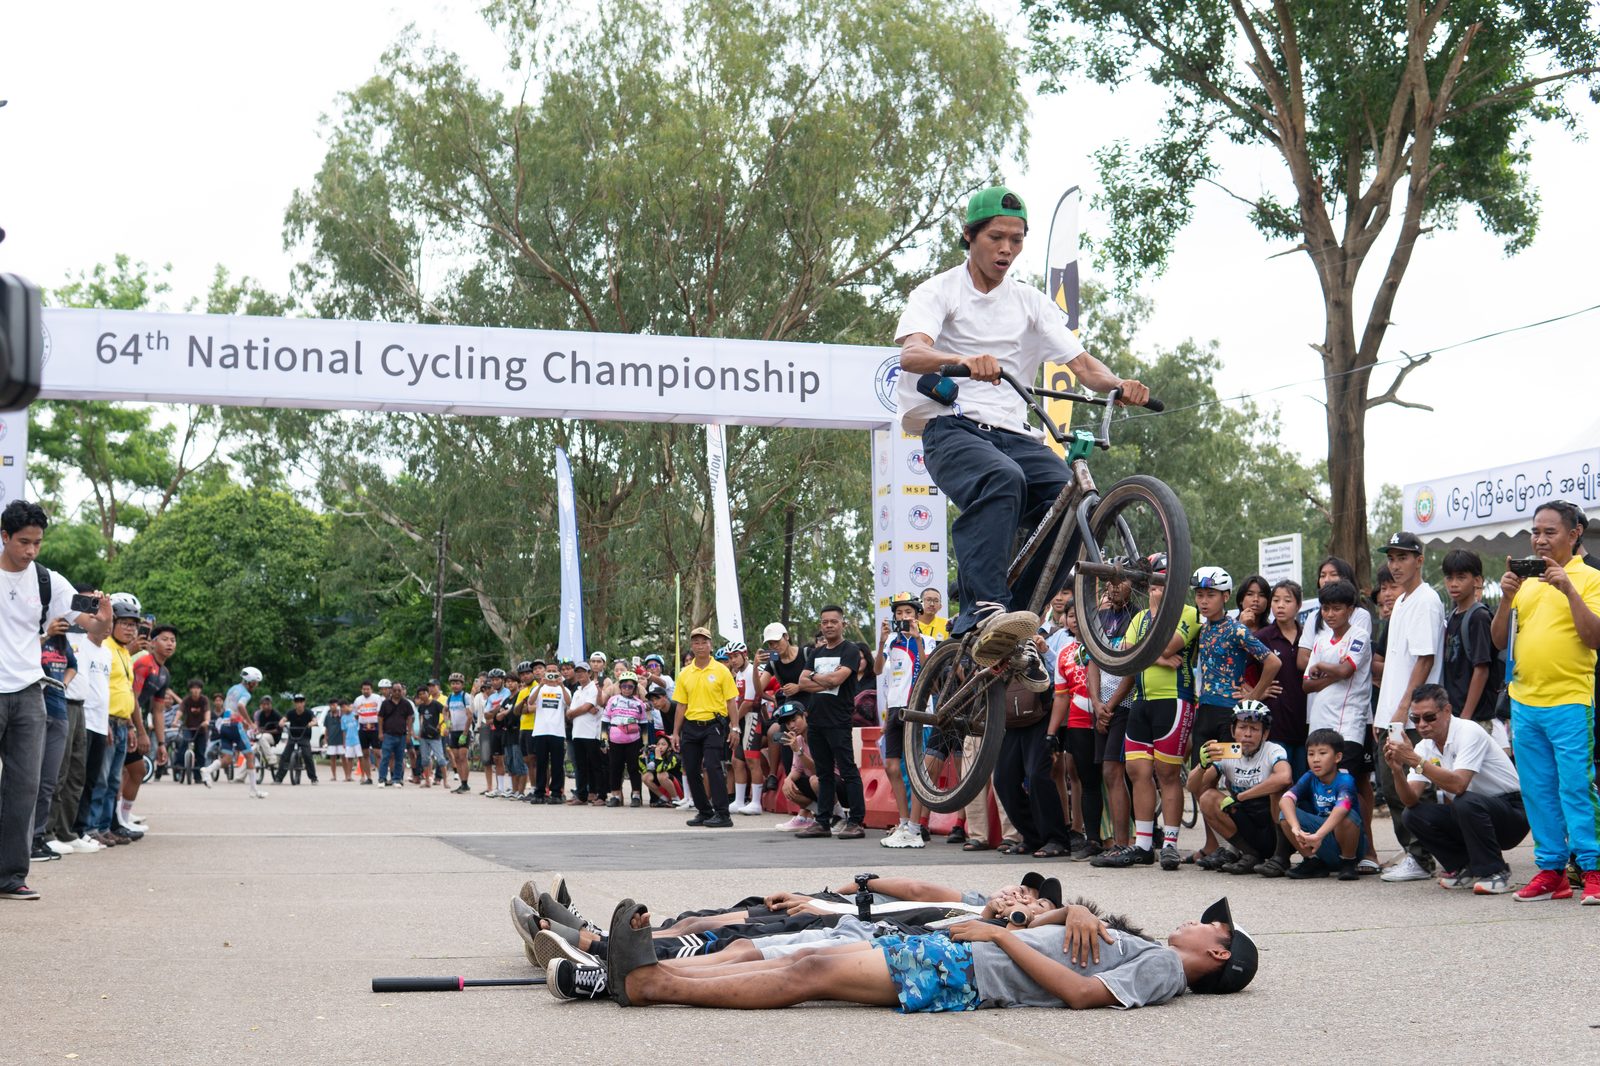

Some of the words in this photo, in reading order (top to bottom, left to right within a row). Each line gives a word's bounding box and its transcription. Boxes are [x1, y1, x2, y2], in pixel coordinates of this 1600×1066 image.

[96, 331, 169, 365] 64th
[188, 335, 363, 375] National
[380, 344, 527, 392] Cycling
[542, 350, 820, 403] Championship
